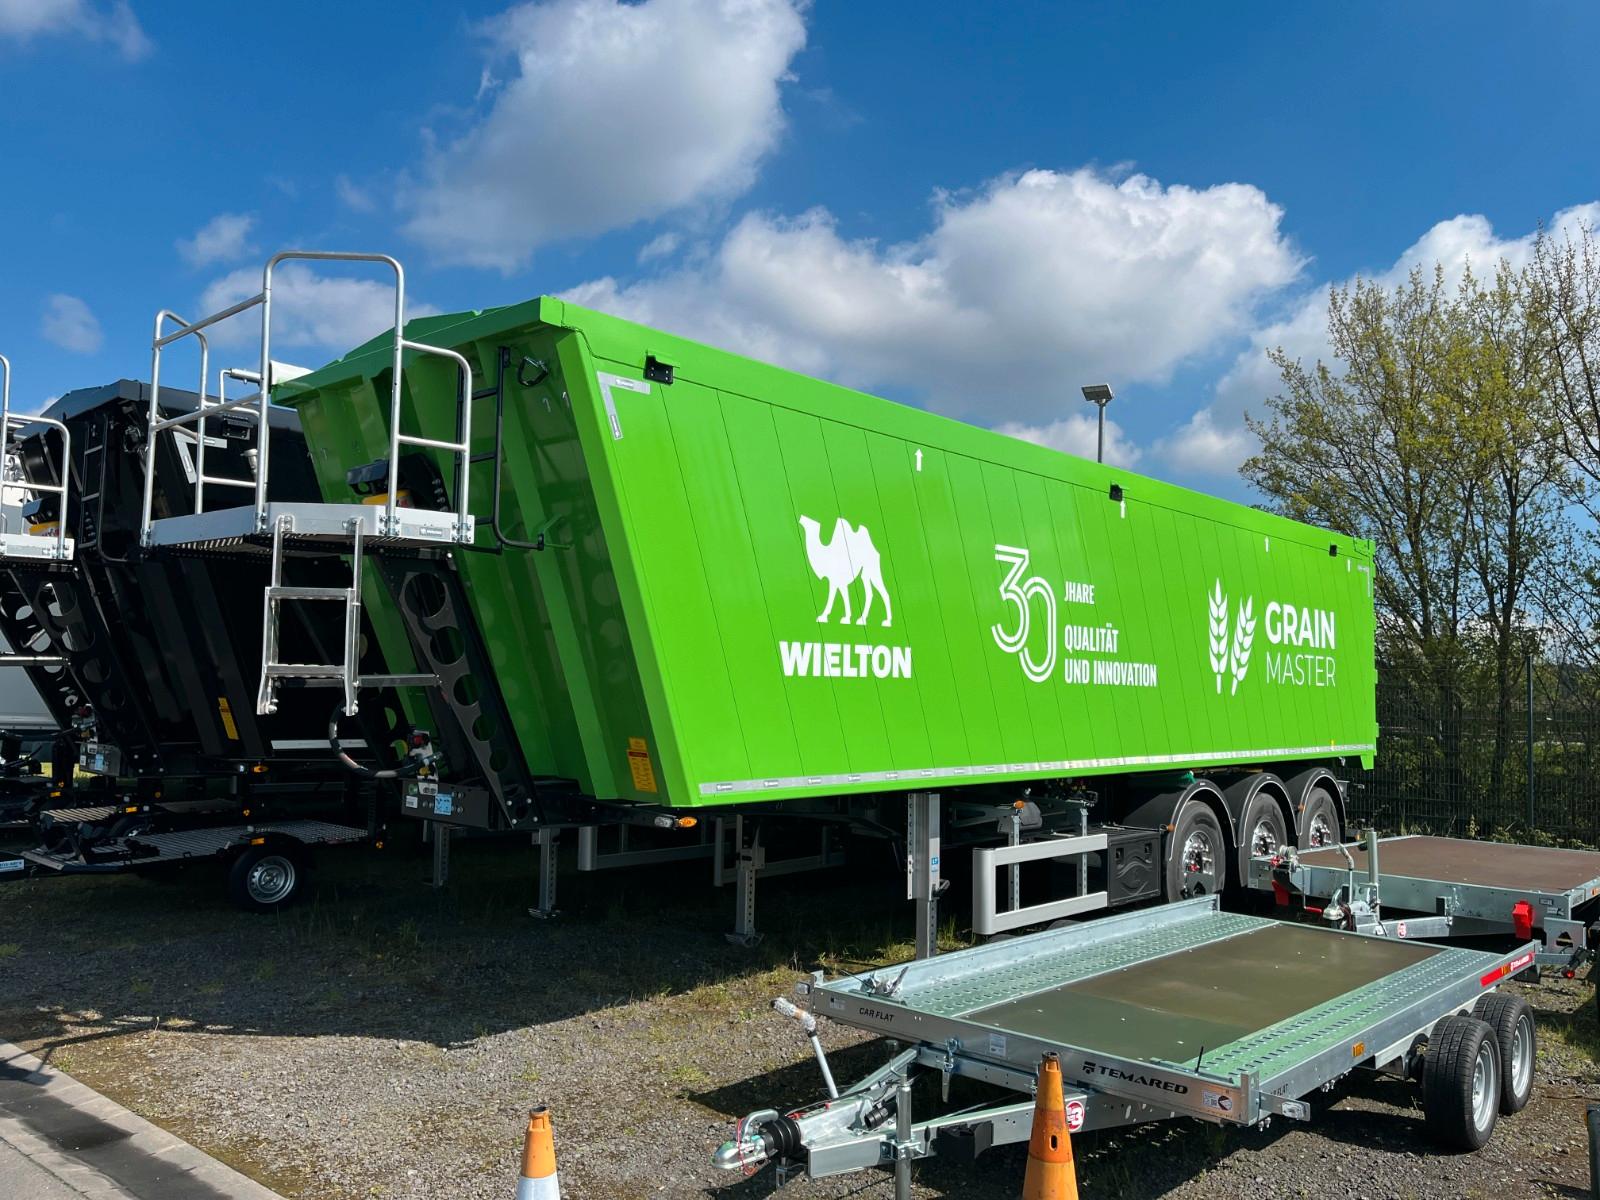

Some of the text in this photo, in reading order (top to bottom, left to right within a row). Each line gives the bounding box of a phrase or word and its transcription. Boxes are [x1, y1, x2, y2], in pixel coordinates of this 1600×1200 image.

[1064, 581, 1095, 605] JHARE
[991, 544, 1057, 683] 30
[1265, 601, 1335, 650] GRAIN
[1064, 623, 1119, 654] QUALITÄT
[779, 640, 912, 679] WIELTON
[1064, 658, 1157, 687] UND INNOVATION
[1266, 651, 1336, 687] MASTER
[859, 1007, 895, 1022] CAR FLAT
[1098, 1065, 1188, 1095] TEMARED
